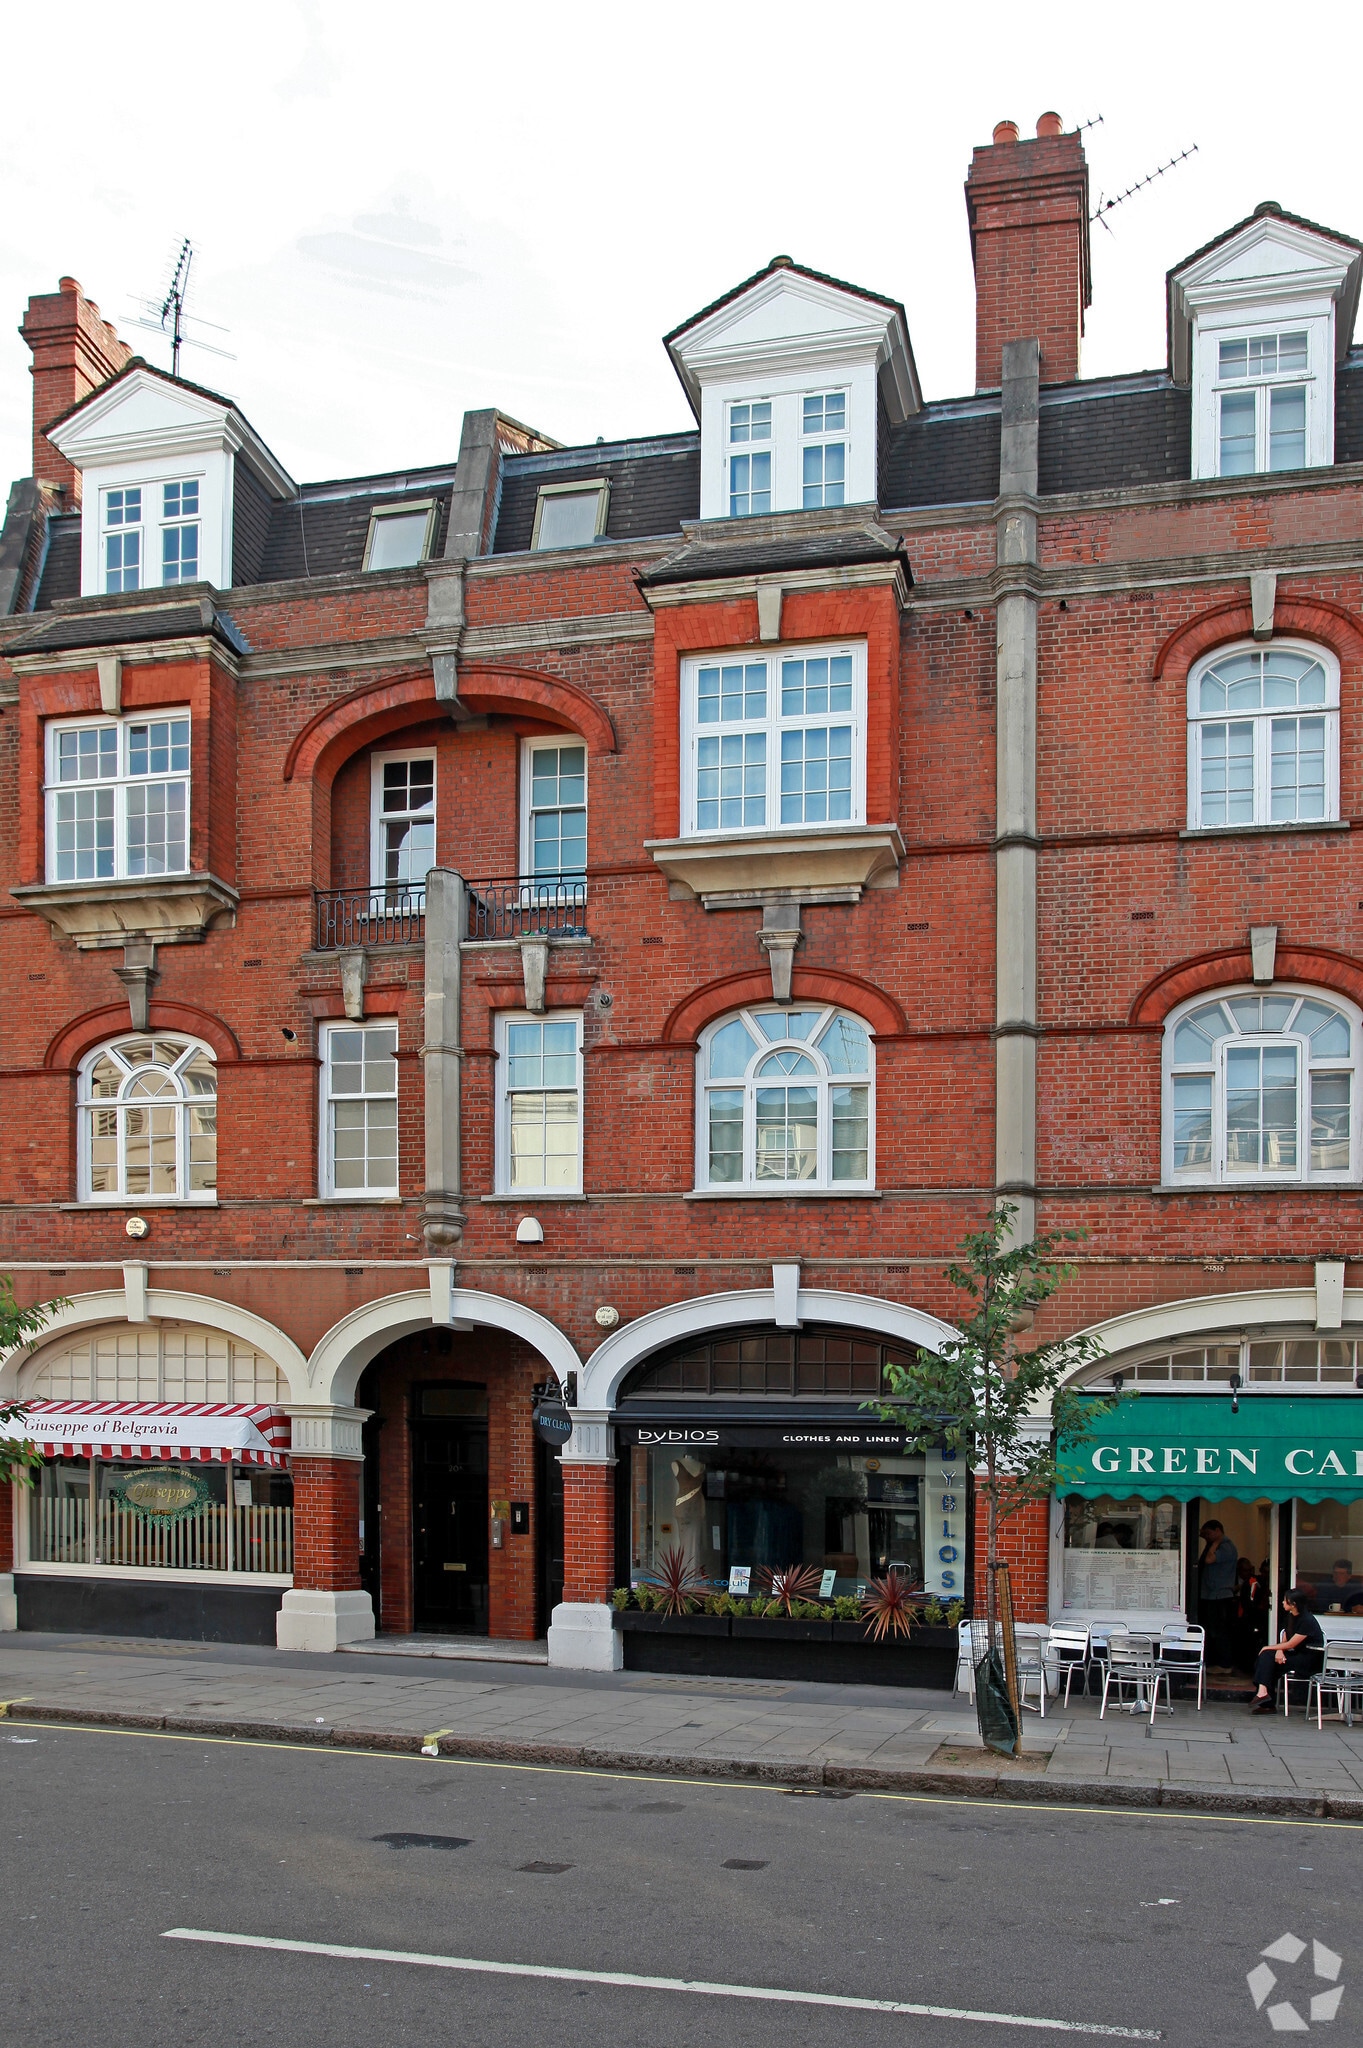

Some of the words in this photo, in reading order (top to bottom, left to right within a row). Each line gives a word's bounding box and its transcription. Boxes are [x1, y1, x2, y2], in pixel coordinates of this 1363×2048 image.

[24, 1418, 89, 1436] Giuseppe
[93, 1419, 109, 1433] of
[112, 1420, 178, 1438] Belgravia
[540, 1415, 551, 1427] DRY
[552, 1418, 571, 1431] CLEAN
[638, 1429, 719, 1444] byblos
[835, 1435, 860, 1443] AND
[1091, 1446, 1260, 1475] GREEN
[181, 1469, 200, 1482] STYLIST
[132, 1483, 191, 1502] Giuseppe
